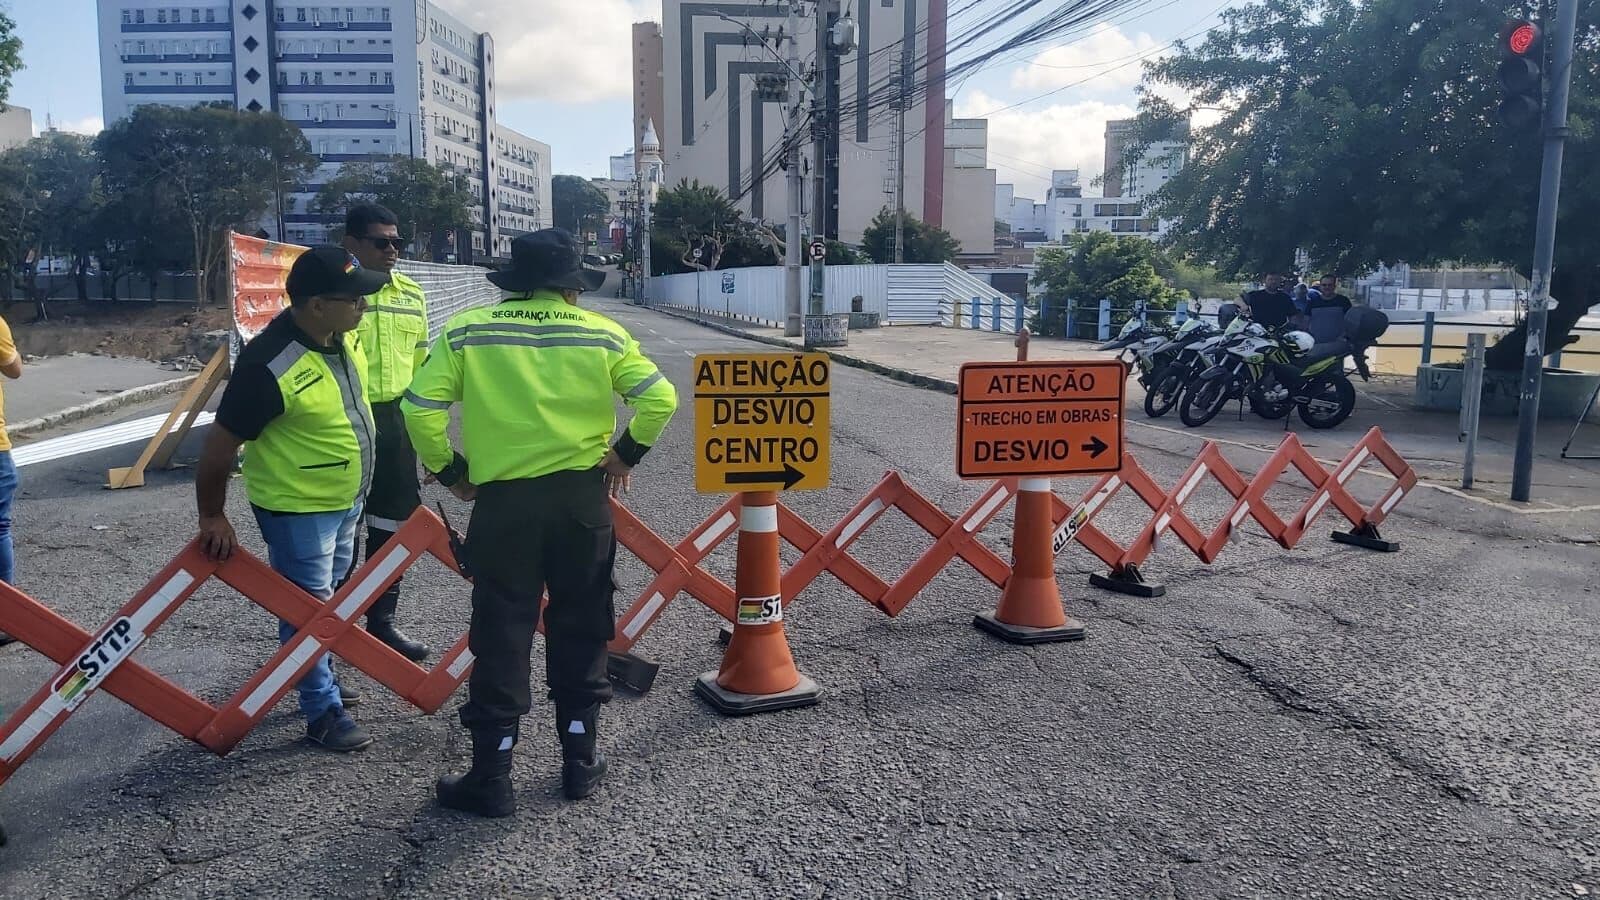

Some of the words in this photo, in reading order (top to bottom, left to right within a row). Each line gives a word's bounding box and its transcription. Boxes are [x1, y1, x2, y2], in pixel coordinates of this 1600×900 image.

[492, 310, 551, 323] SEGURANÇA
[695, 355, 829, 393] ATENÇÃO
[987, 369, 1095, 397] ATENÇÃO
[713, 399, 815, 425] DESVIO
[972, 410, 1032, 426] TRECHO
[1036, 410, 1057, 424] EM
[1061, 408, 1111, 423] OBRAS
[705, 437, 819, 464] CENTRO
[974, 439, 1070, 463] DESVIO
[1053, 519, 1077, 552] STTP
[78, 619, 131, 678] STTP
